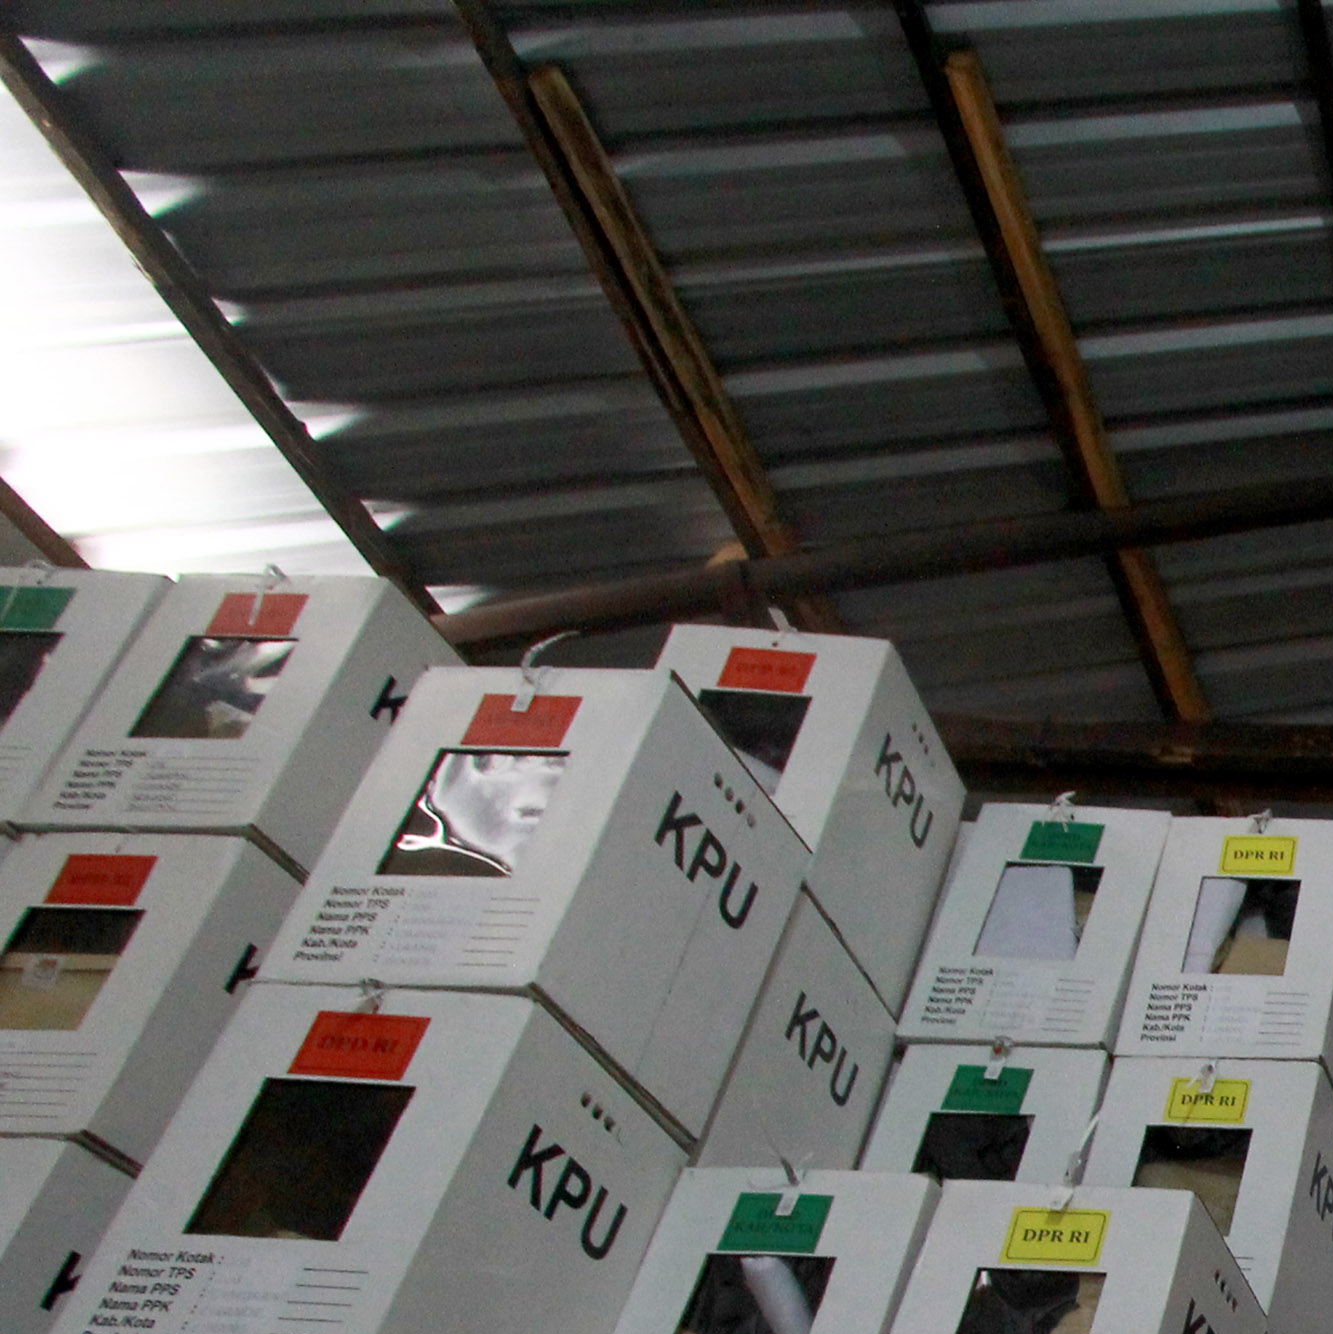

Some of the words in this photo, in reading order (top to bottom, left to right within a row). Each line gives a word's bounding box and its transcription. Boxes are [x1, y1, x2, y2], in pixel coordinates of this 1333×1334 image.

[875, 733, 934, 849] KPU
[655, 790, 759, 930] KPU
[1233, 850, 1264, 861] DPR
[1269, 851, 1285, 861] RI
[785, 991, 860, 1108] KPU
[1181, 1094, 1214, 1106] DPR
[1219, 1096, 1236, 1107] RI
[507, 1124, 627, 1260] KPU
[1022, 1229, 1063, 1243] DPR
[1069, 1231, 1091, 1245] RI
